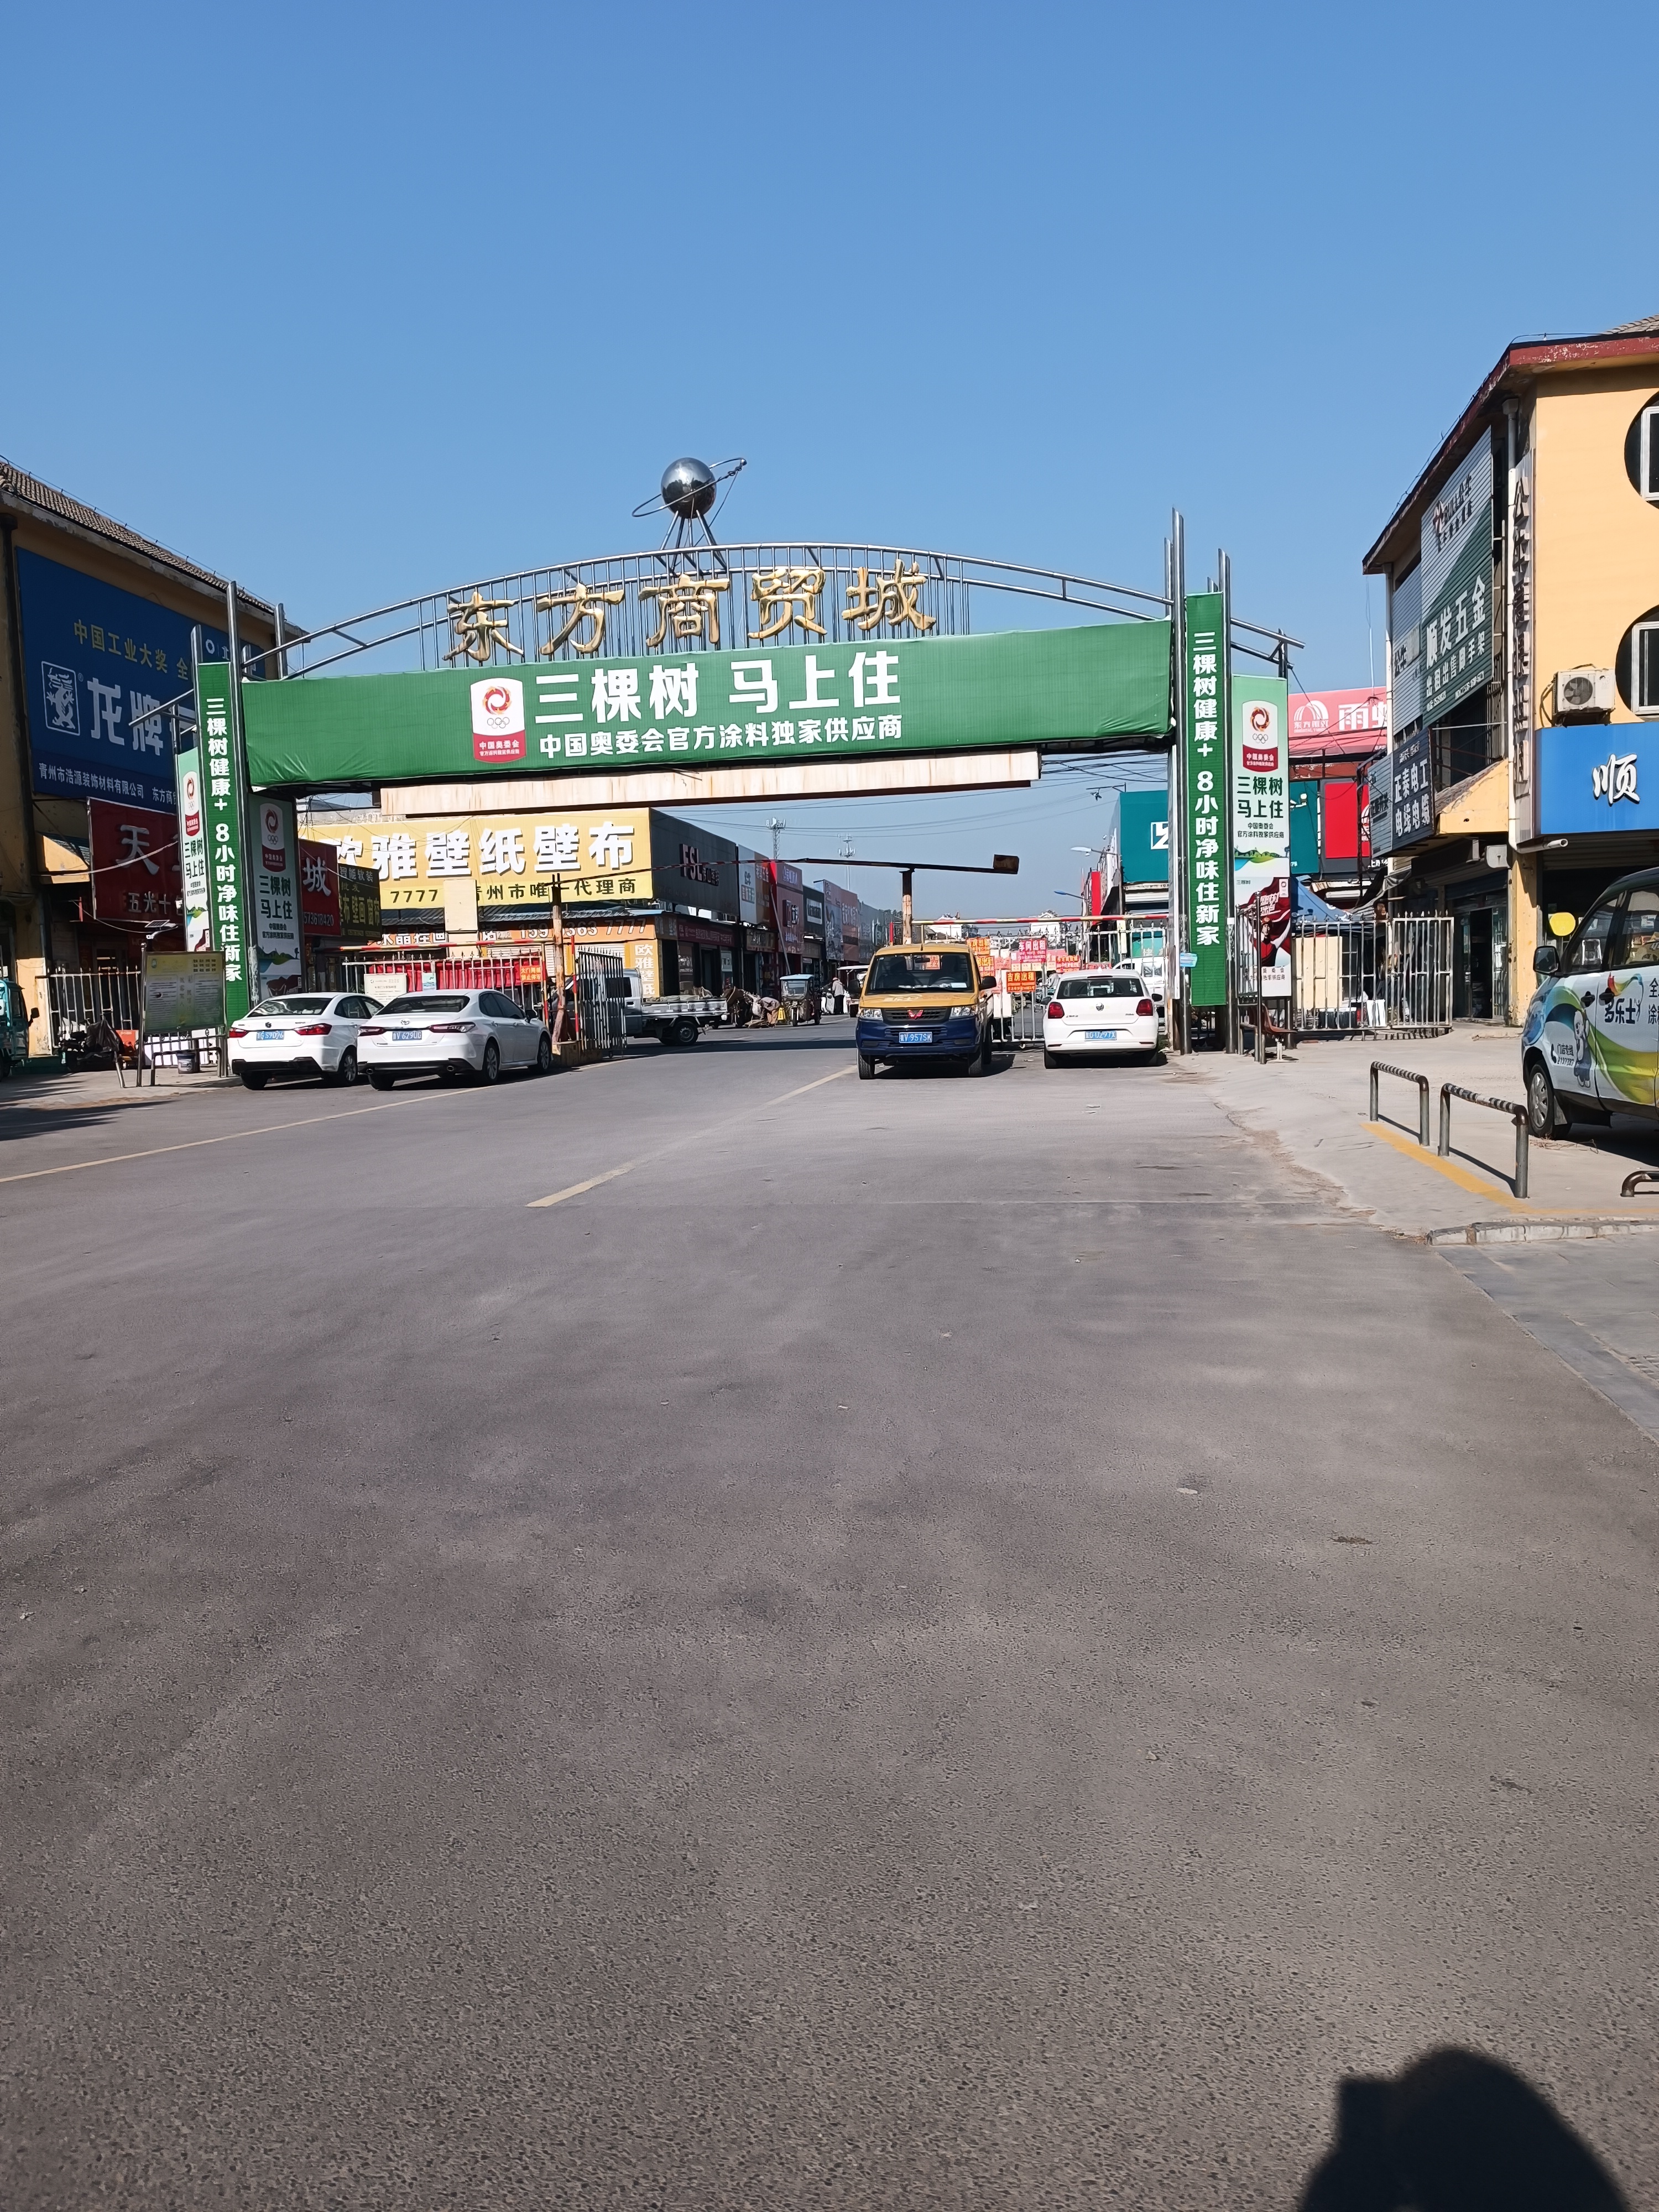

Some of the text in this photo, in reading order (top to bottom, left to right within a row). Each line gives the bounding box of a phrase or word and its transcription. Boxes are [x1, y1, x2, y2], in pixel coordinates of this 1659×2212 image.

[442, 559, 937, 661] 东方商贸城
[1426, 575, 1485, 670] 顺发五金
[74, 619, 168, 674] 中国工业大奖
[535, 650, 902, 725] 三棵树 马上住
[478, 739, 520, 750] 中国奥委会
[539, 713, 903, 759] 中国奥委会官方涂料独家供应商
[206, 697, 231, 811] 三棵树健康+
[1246, 753, 1274, 761] 中国奥委会
[39, 763, 144, 799] 青州市浩源装饰材料有限公司
[1192, 630, 1220, 946] 三棵树健康+ 8小时净味住新家
[1237, 776, 1283, 796] 三棵树
[1593, 753, 1641, 806] 顺
[1237, 799, 1284, 818] 马上住
[1395, 793, 1430, 837] 电线电缆
[301, 856, 332, 896] 城
[339, 866, 373, 883] 智能软装
[682, 843, 702, 881] FSL
[259, 875, 291, 897] 三棵树
[341, 881, 361, 893] 批发
[390, 889, 439, 903] 7777
[260, 899, 293, 920] 马上住
[518, 921, 549, 939] 159
[603, 918, 646, 936] 7777
[1604, 998, 1636, 1024] 多乐士
[1648, 1004, 1659, 1025] 涂
